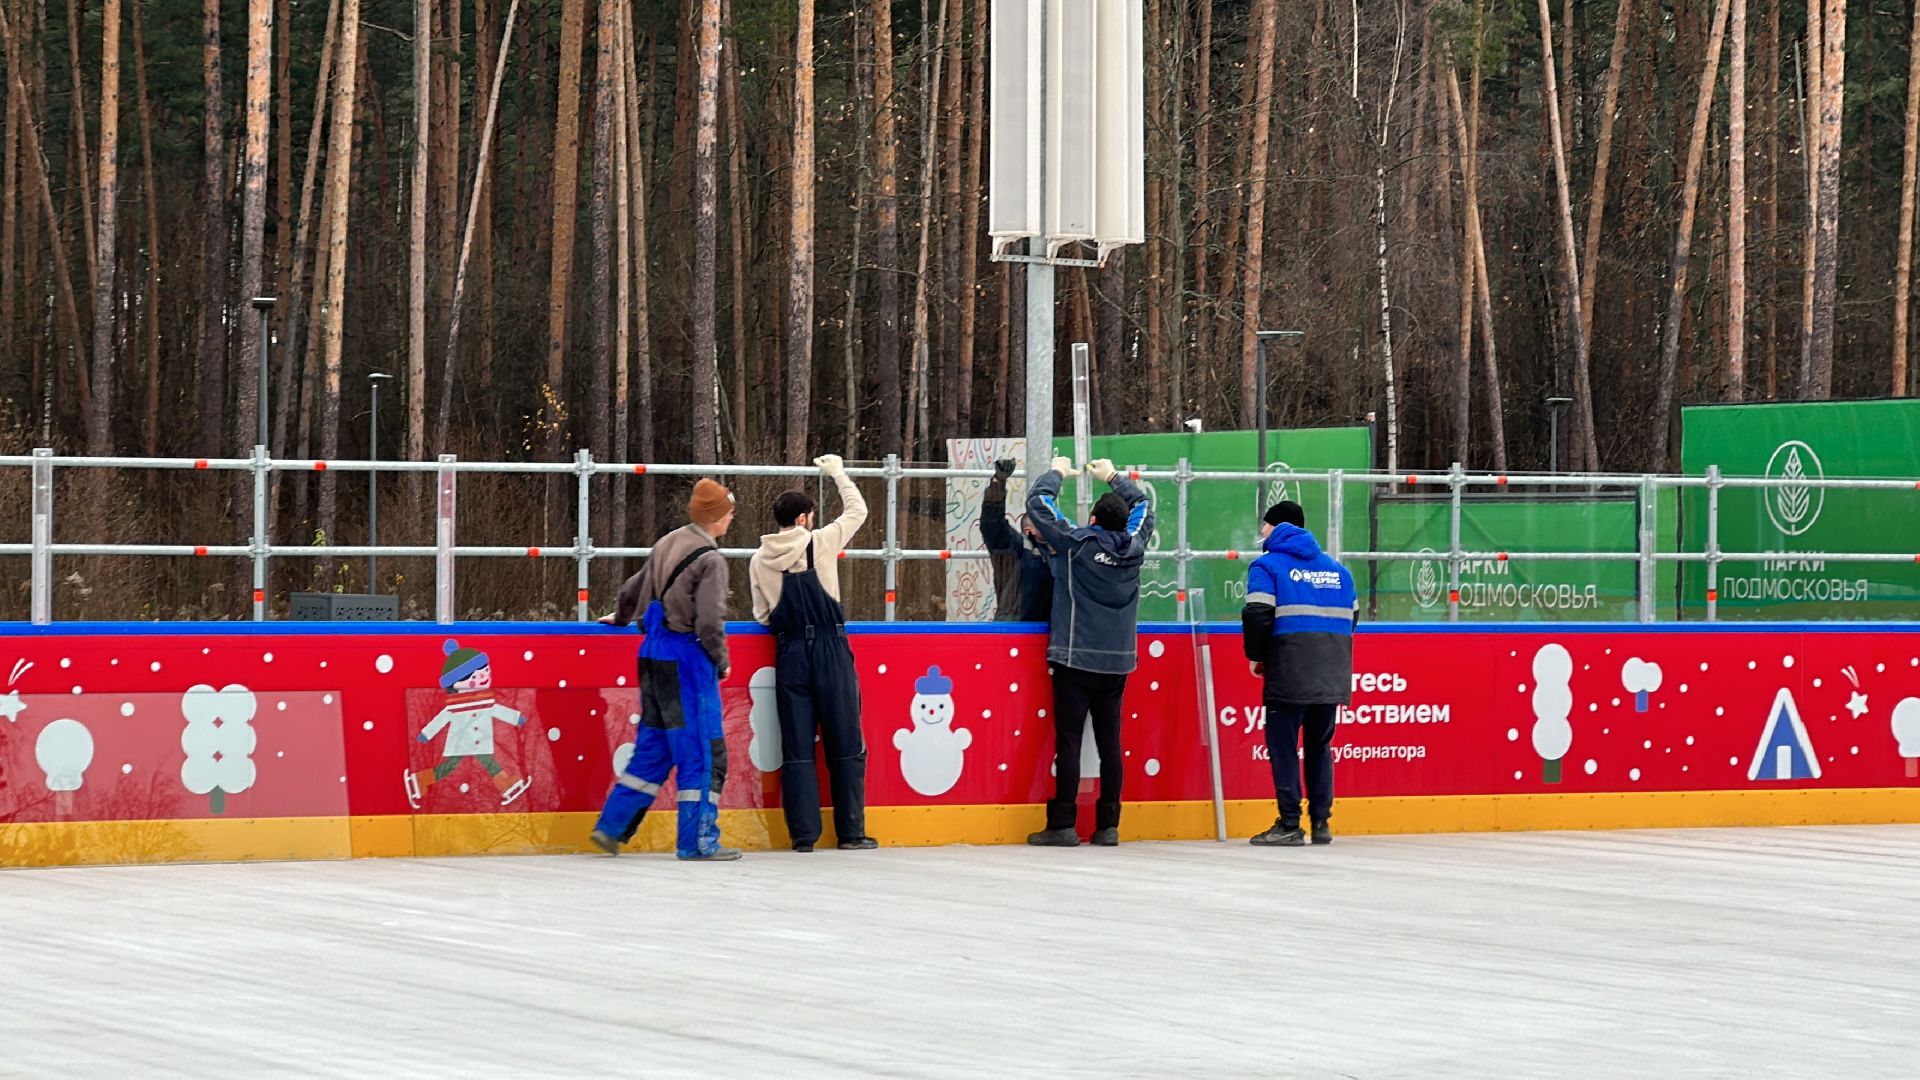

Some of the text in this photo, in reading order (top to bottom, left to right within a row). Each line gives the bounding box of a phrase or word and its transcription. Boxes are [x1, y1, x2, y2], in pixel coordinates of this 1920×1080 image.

[1447, 552, 1509, 575] АРКИ
[1763, 550, 1825, 572] ПАРКИ
[1723, 577, 1868, 601] ПОДМОСКОВЬЯ
[1351, 672, 1408, 693] тесь
[1220, 703, 1450, 734] с уьствием
[1331, 743, 1426, 763] убернатора
